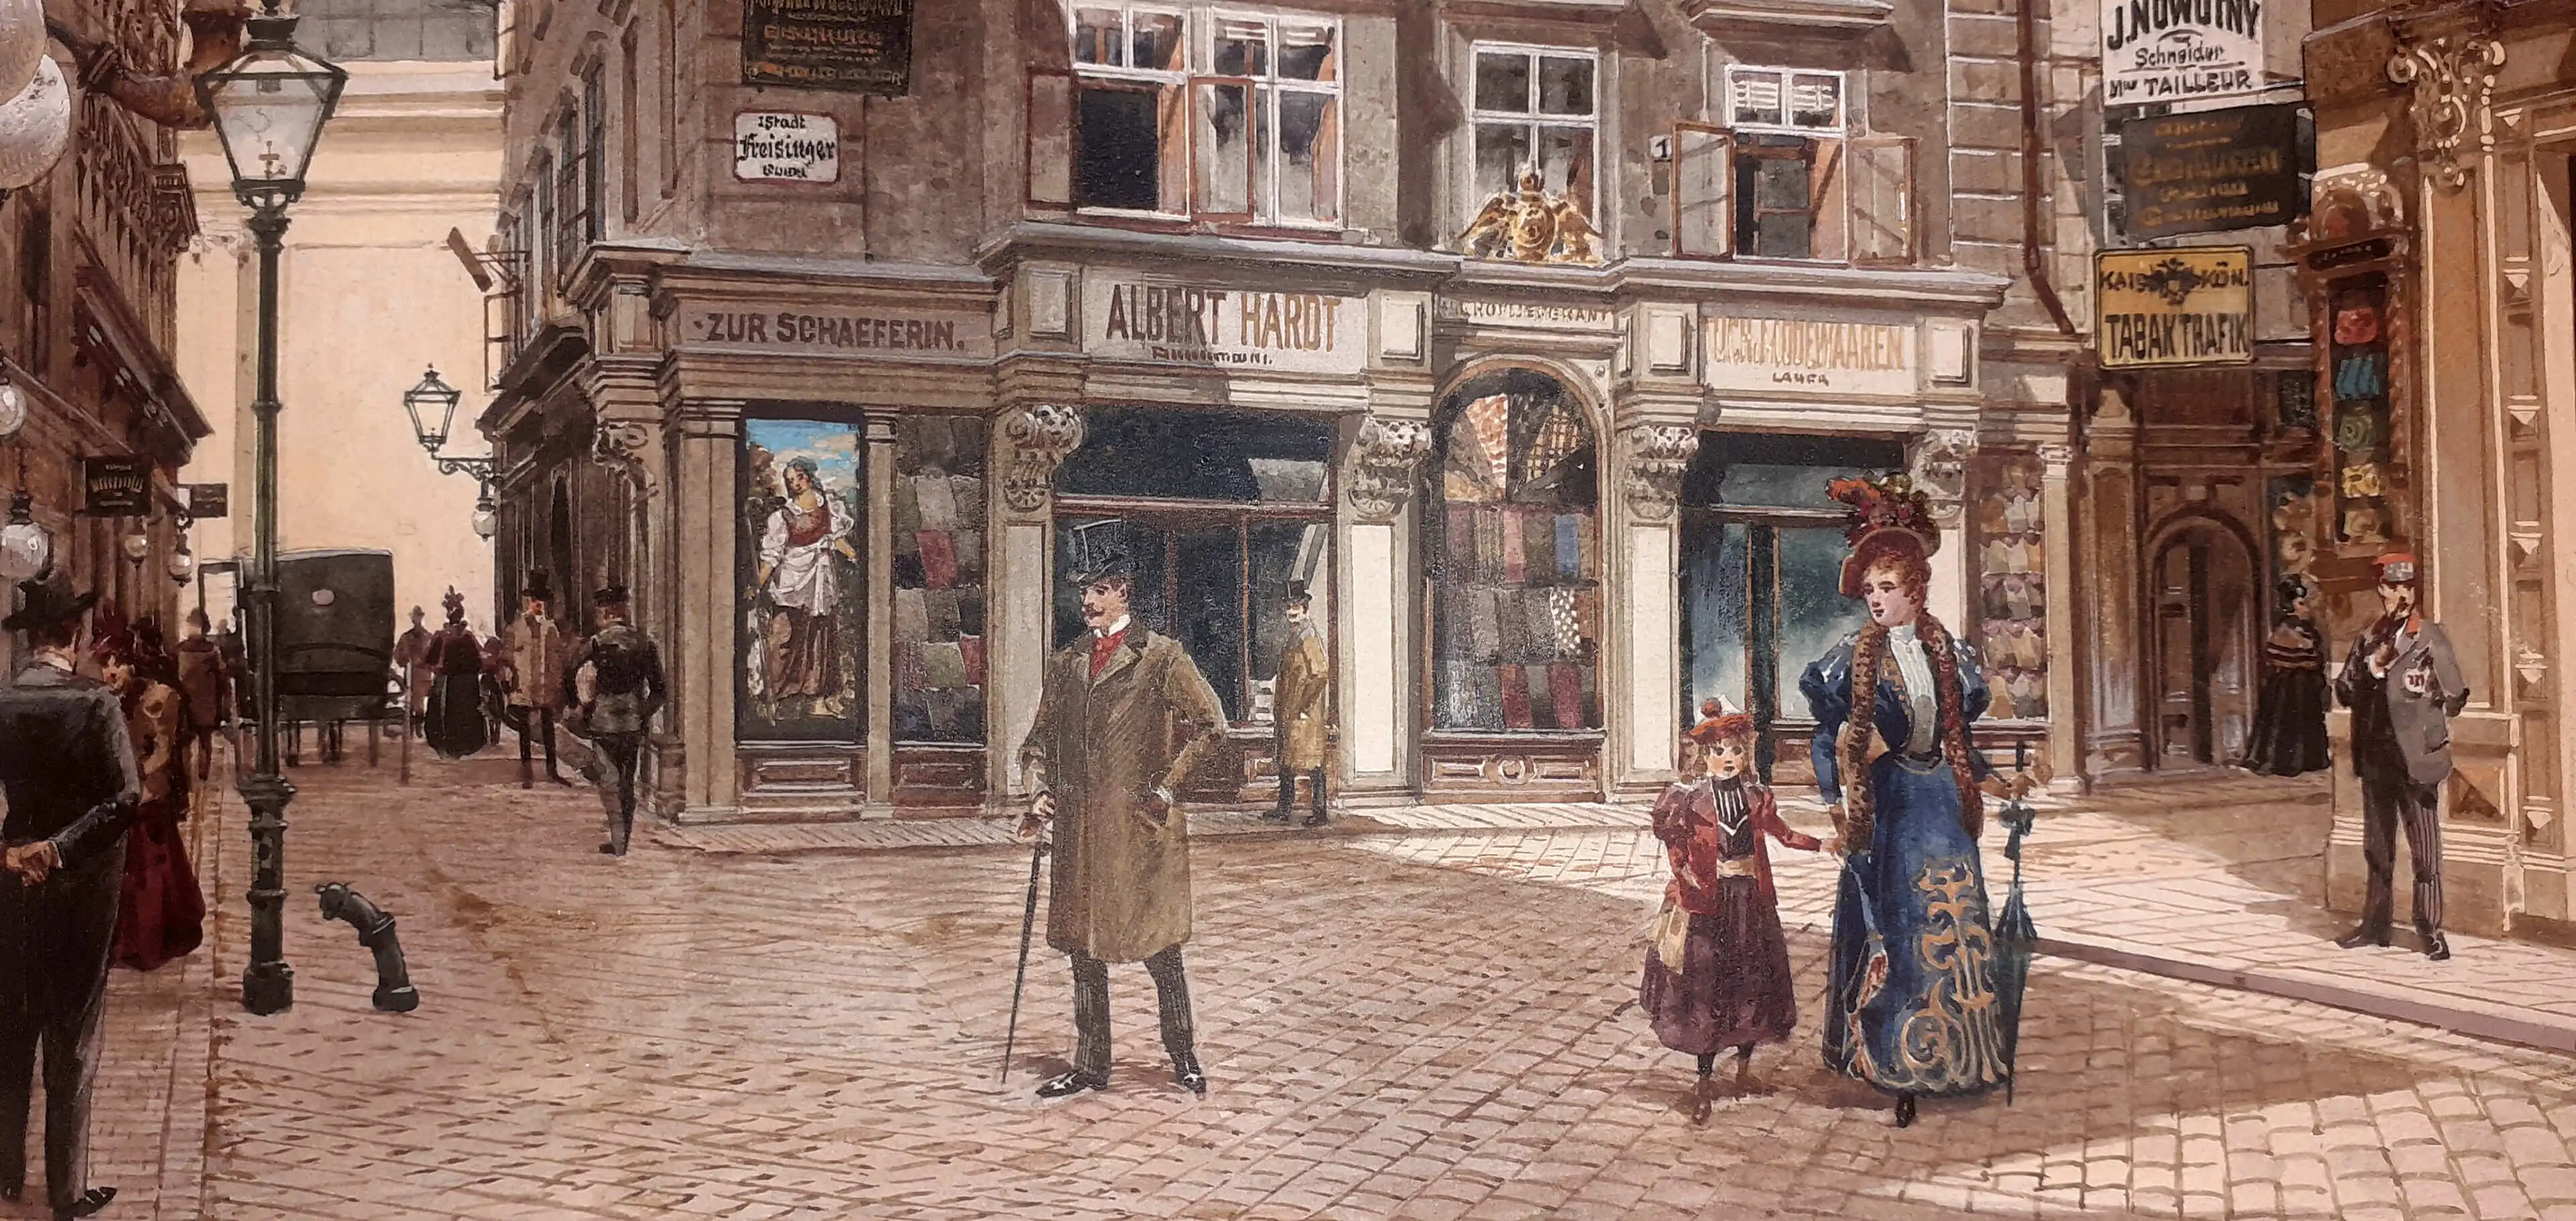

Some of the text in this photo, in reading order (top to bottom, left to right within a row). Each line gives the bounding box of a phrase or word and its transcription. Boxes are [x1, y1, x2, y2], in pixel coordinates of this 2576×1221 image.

[2144, 69, 2252, 97] TAILLEUR
[737, 133, 835, 166] Freisinger
[1106, 284, 1341, 352] ALBERT HARDT
[2105, 313, 2249, 360] TABAK TRAFIK
